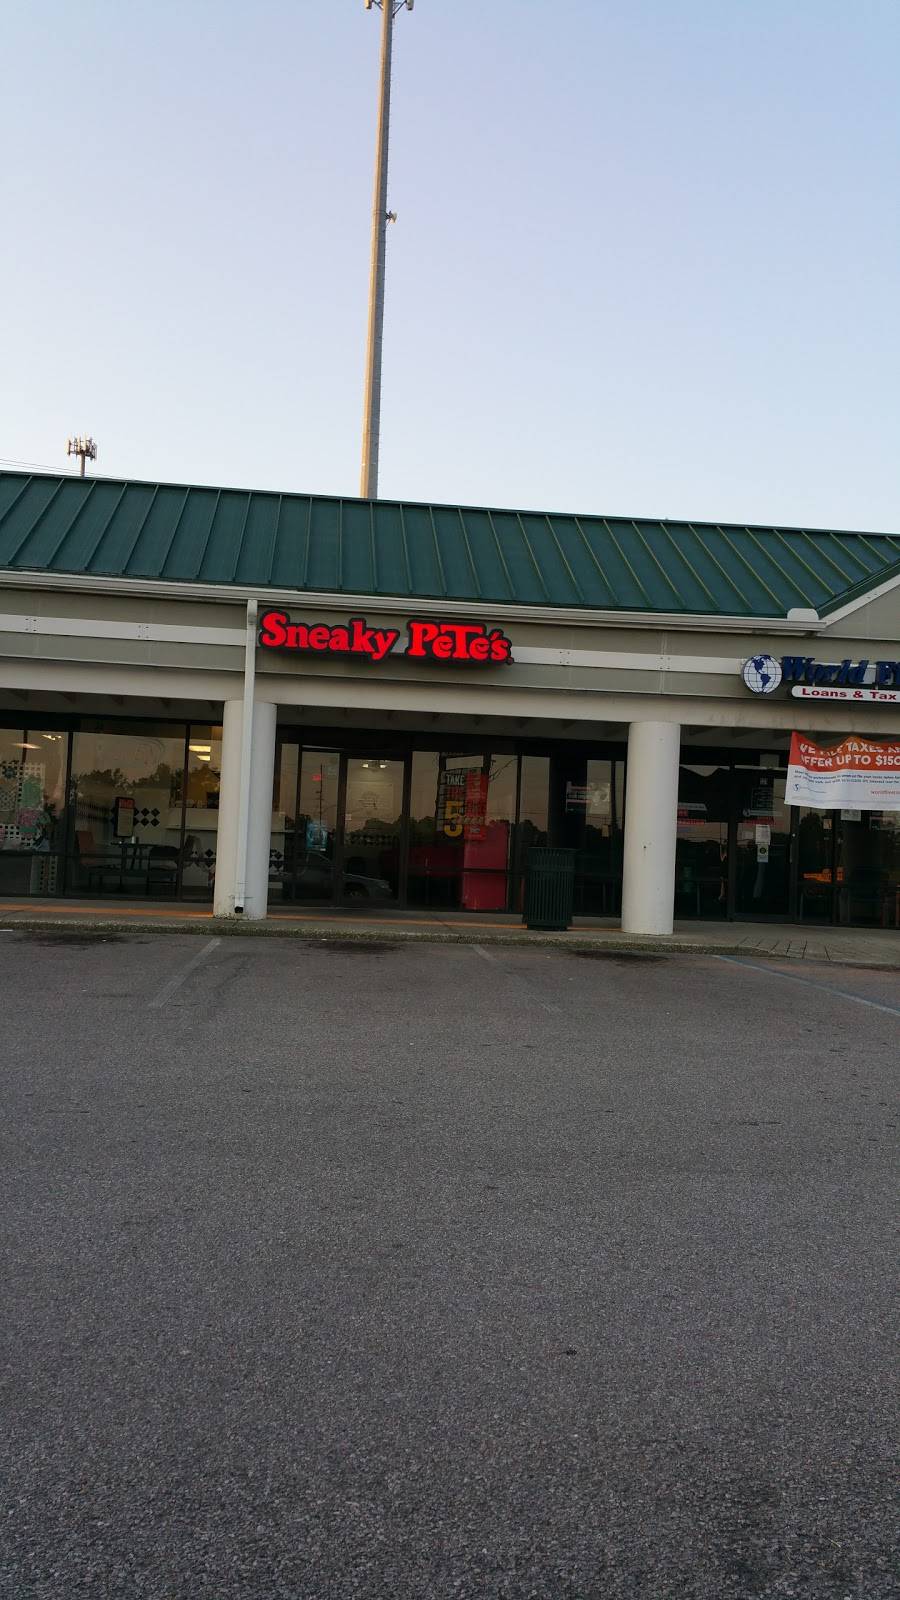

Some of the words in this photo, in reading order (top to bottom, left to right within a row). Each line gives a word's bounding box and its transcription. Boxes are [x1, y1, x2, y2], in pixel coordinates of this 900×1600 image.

[260, 611, 398, 661] Sneaky
[782, 656, 869, 684] World
[875, 661, 900, 685] F
[801, 687, 847, 699] Loans
[852, 689, 864, 699] &
[869, 690, 897, 701] Tax
[836, 753, 852, 766] UP
[853, 754, 871, 765] TO
[446, 774, 465, 786] TAKE
